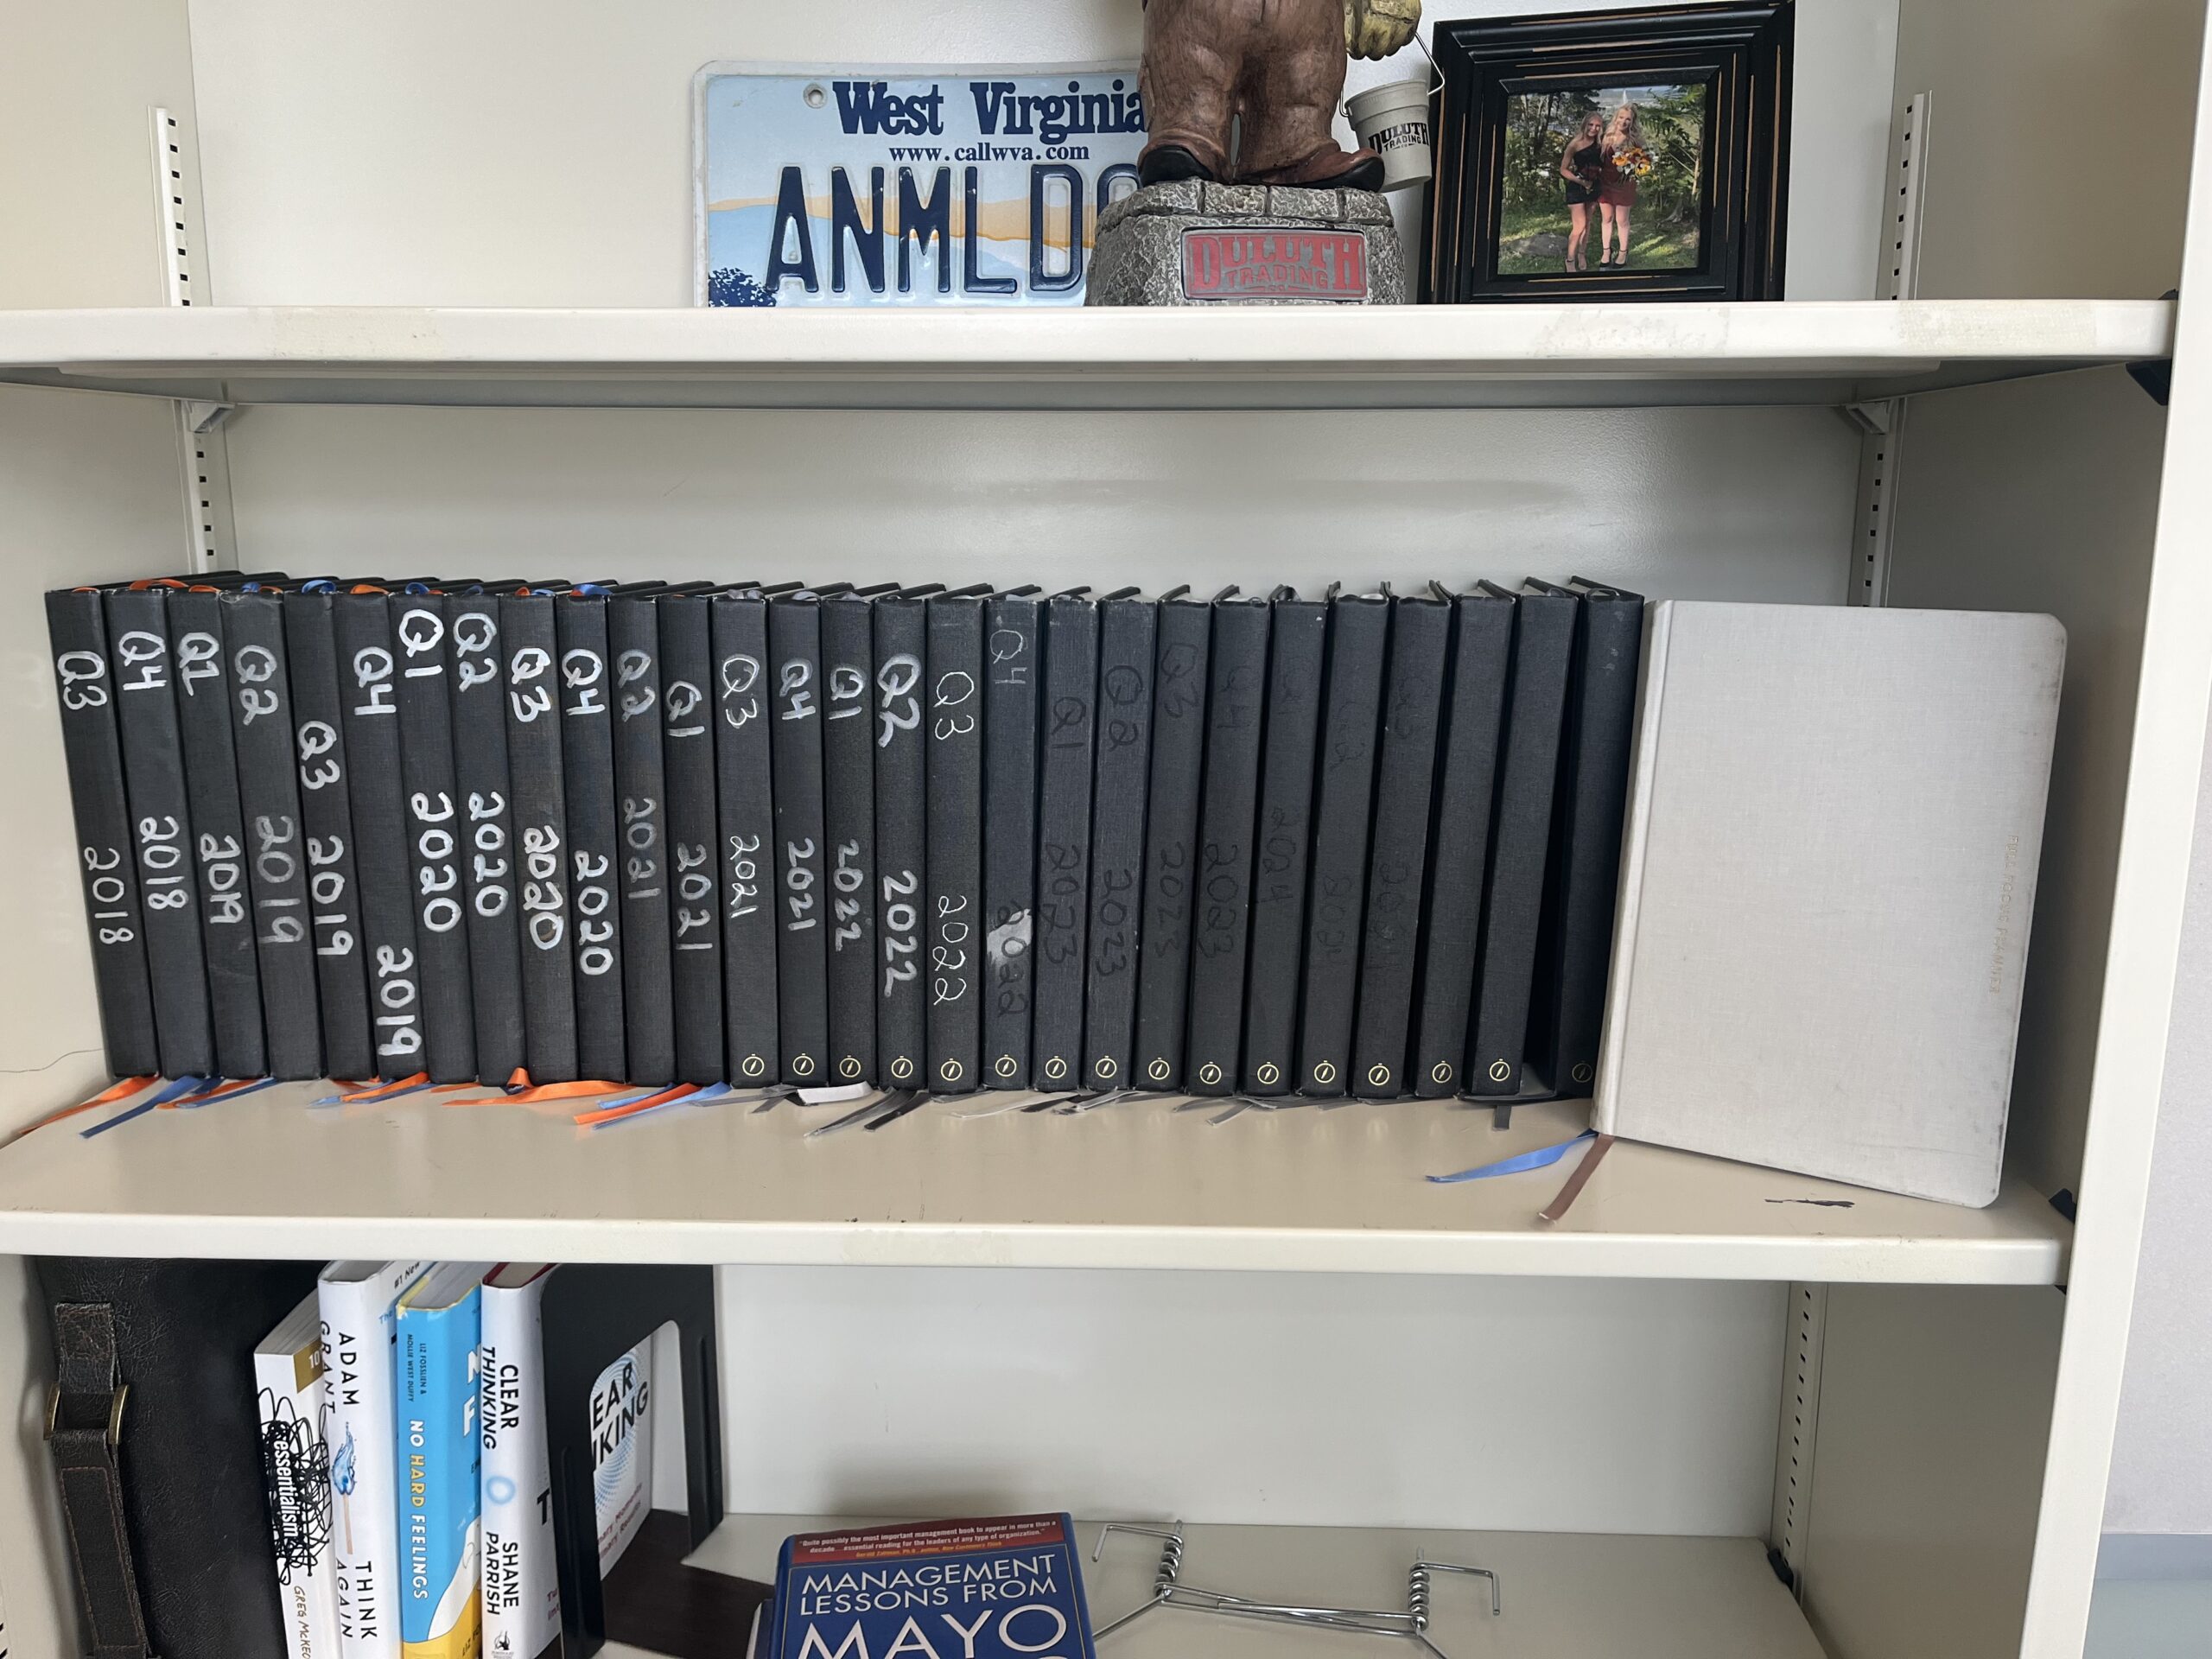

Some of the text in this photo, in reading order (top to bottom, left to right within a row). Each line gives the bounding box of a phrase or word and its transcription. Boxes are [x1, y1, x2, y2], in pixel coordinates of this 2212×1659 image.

[832, 79, 1147, 144] West Virginia
[889, 143, 1090, 162] www.callwva.com
[1368, 123, 1430, 154] DULUTH
[1383, 135, 1421, 151] TRADING
[1192, 236, 1363, 290] DULUTH
[1225, 264, 1328, 290] TRADING
[178, 632, 220, 696] Q1
[58, 651, 134, 944] Q3 2018
[118, 630, 188, 910] Q4 2018
[235, 645, 304, 944] Q2 2019
[399, 608, 461, 932] Q1 2020
[453, 612, 509, 918] Q2 2020
[510, 647, 564, 950] Q3 2020
[562, 648, 613, 976] Q4 2020
[616, 648, 662, 899] Q2 2021
[666, 679, 713, 950] Q1 2021
[722, 653, 760, 918] Q3 2021
[779, 658, 817, 931] Q4 2021
[829, 664, 864, 951] Q1 2022
[298, 720, 353, 955] Q3 2019
[353, 645, 422, 1056] Q4 2019
[877, 652, 921, 997] Q2 2022
[933, 671, 975, 1006] Q3 2022
[990, 629, 1028, 1018] Q4 2022
[1040, 696, 1085, 964] Q1 2023
[1096, 665, 1144, 976] Q2 2023
[321, 1320, 335, 1414] GRANT
[339, 1332, 359, 1407] ADAM
[481, 1346, 499, 1450] THINKING
[499, 1363, 520, 1430] CLEAR
[273, 1440, 302, 1538] essentialism
[410, 1420, 429, 1600] NO HARD FEELINGS
[915, 1528, 957, 1537] management
[294, 1586, 307, 1618] GREG
[336, 1559, 353, 1638] AGAIN
[355, 1560, 378, 1639] THINK
[486, 1532, 500, 1615] PARRISH
[503, 1542, 519, 1608] SHANE
[800, 1577, 1058, 1616] LESSONS FROM
[801, 1554, 1056, 1595] MANAGEMENT
[797, 1604, 1067, 1659] MAYO
